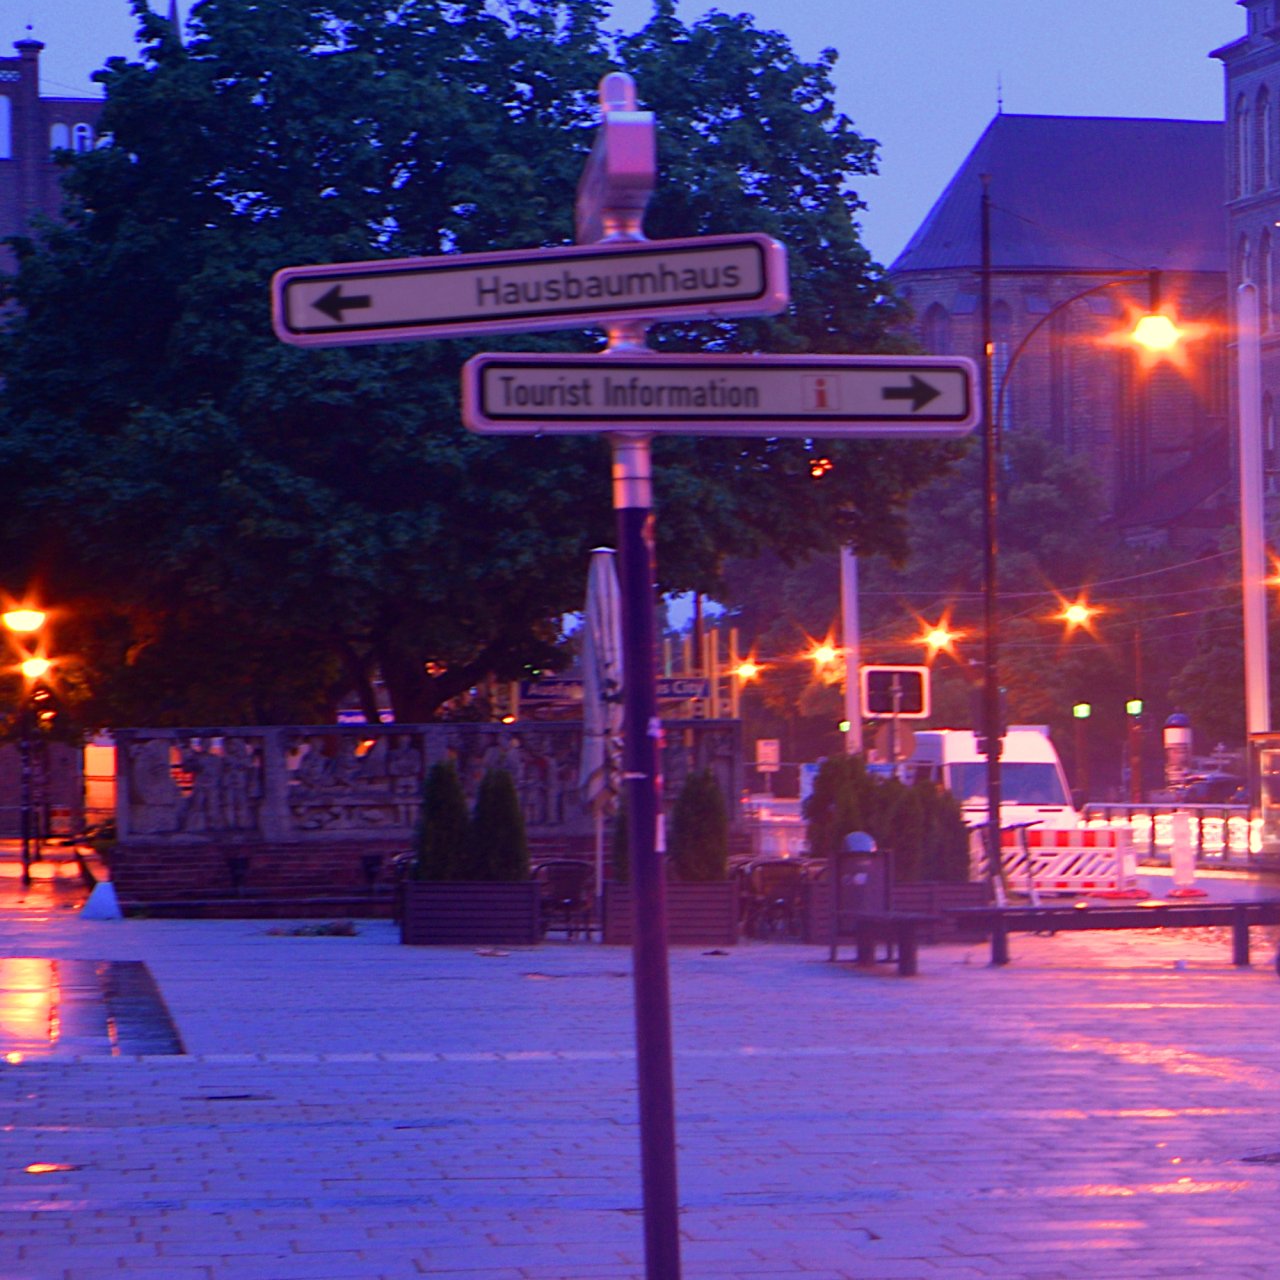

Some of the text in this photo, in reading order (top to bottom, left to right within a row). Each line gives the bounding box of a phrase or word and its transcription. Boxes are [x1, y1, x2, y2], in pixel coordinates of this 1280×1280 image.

[475, 261, 742, 308] Hausbaumhaus
[500, 376, 593, 407] Tourist
[604, 377, 760, 409] Information
